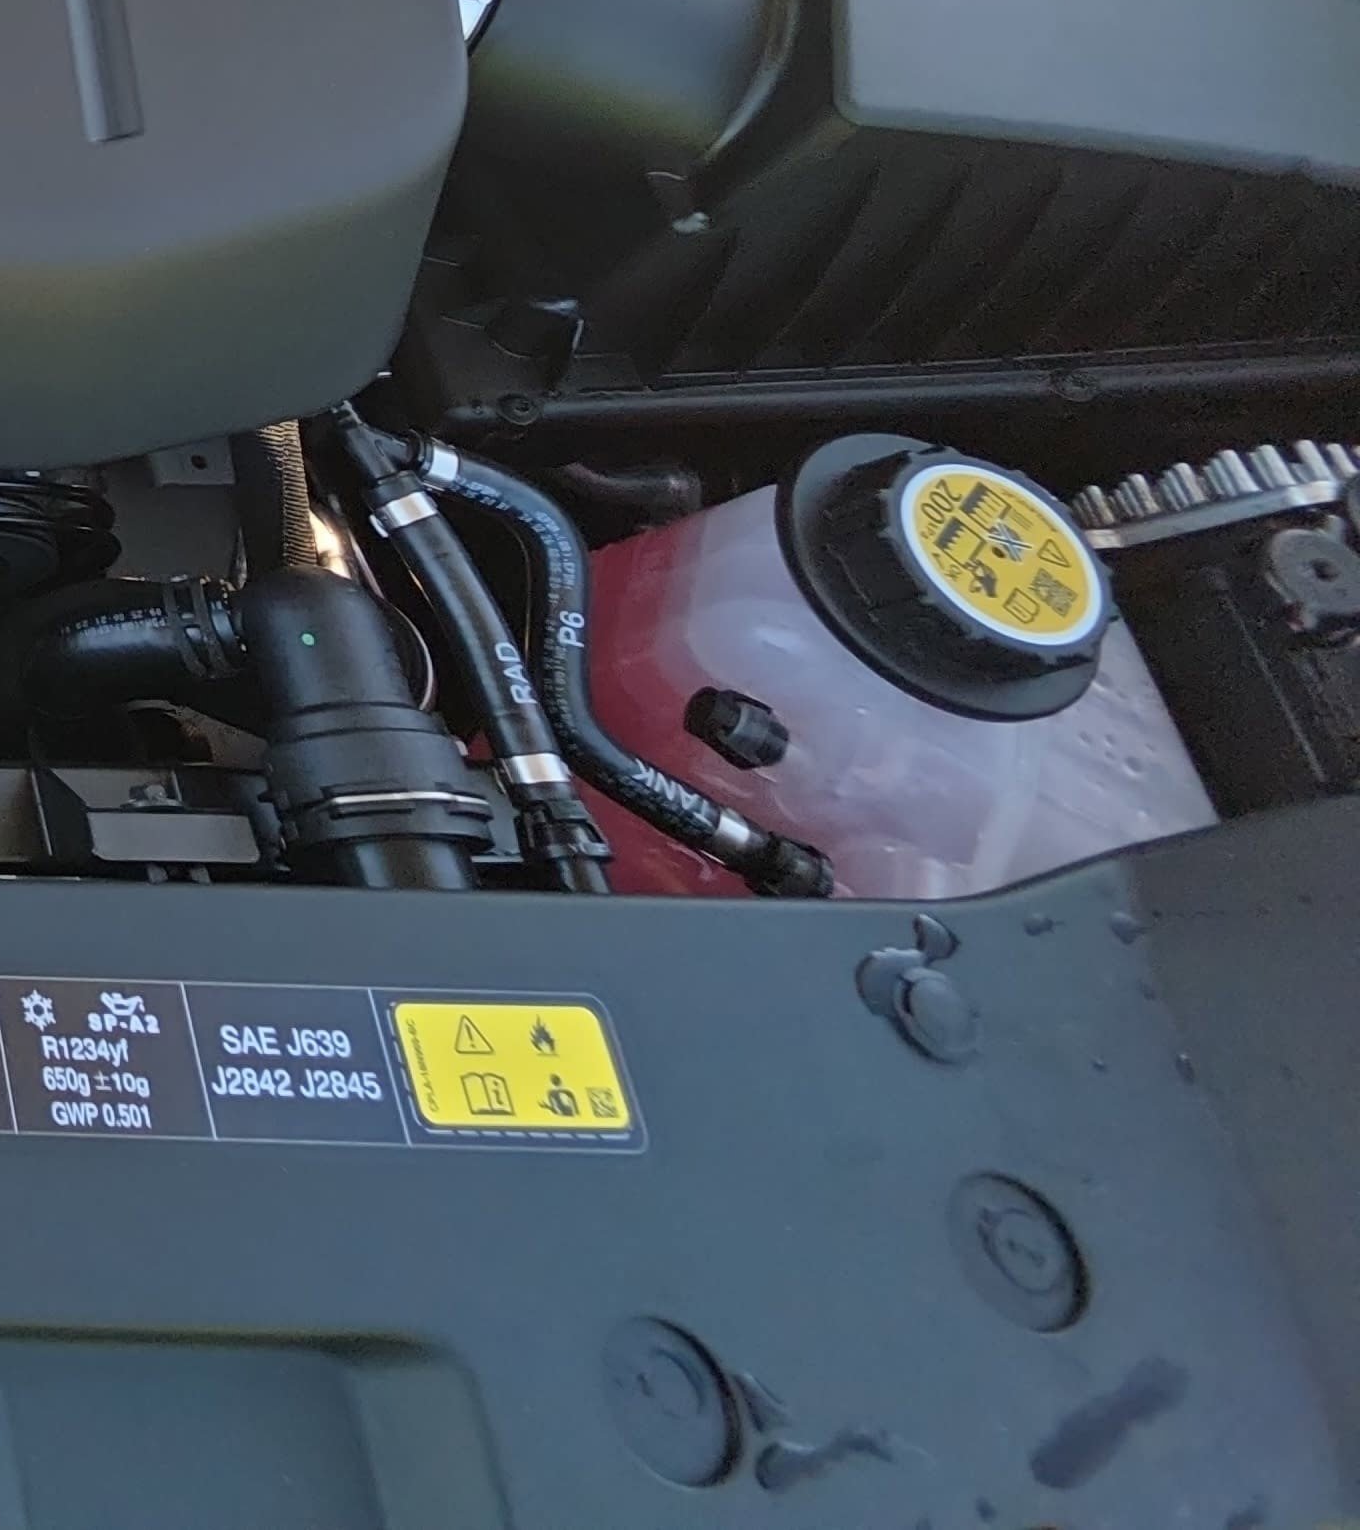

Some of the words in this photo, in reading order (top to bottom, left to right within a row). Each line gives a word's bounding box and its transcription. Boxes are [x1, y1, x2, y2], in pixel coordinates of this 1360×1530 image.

[558, 611, 586, 648] P6
[494, 642, 539, 705] RAD
[631, 758, 714, 826] TANK
[87, 1013, 161, 1034] SP-A2
[40, 1035, 130, 1067] R1234yf
[219, 1025, 281, 1055] SAE
[287, 1028, 352, 1058] J639
[42, 1066, 90, 1097] 650g
[211, 1066, 294, 1099] J2842
[299, 1069, 383, 1101] J2845
[51, 1102, 98, 1127] GWP
[102, 1104, 152, 1129] 0.501
